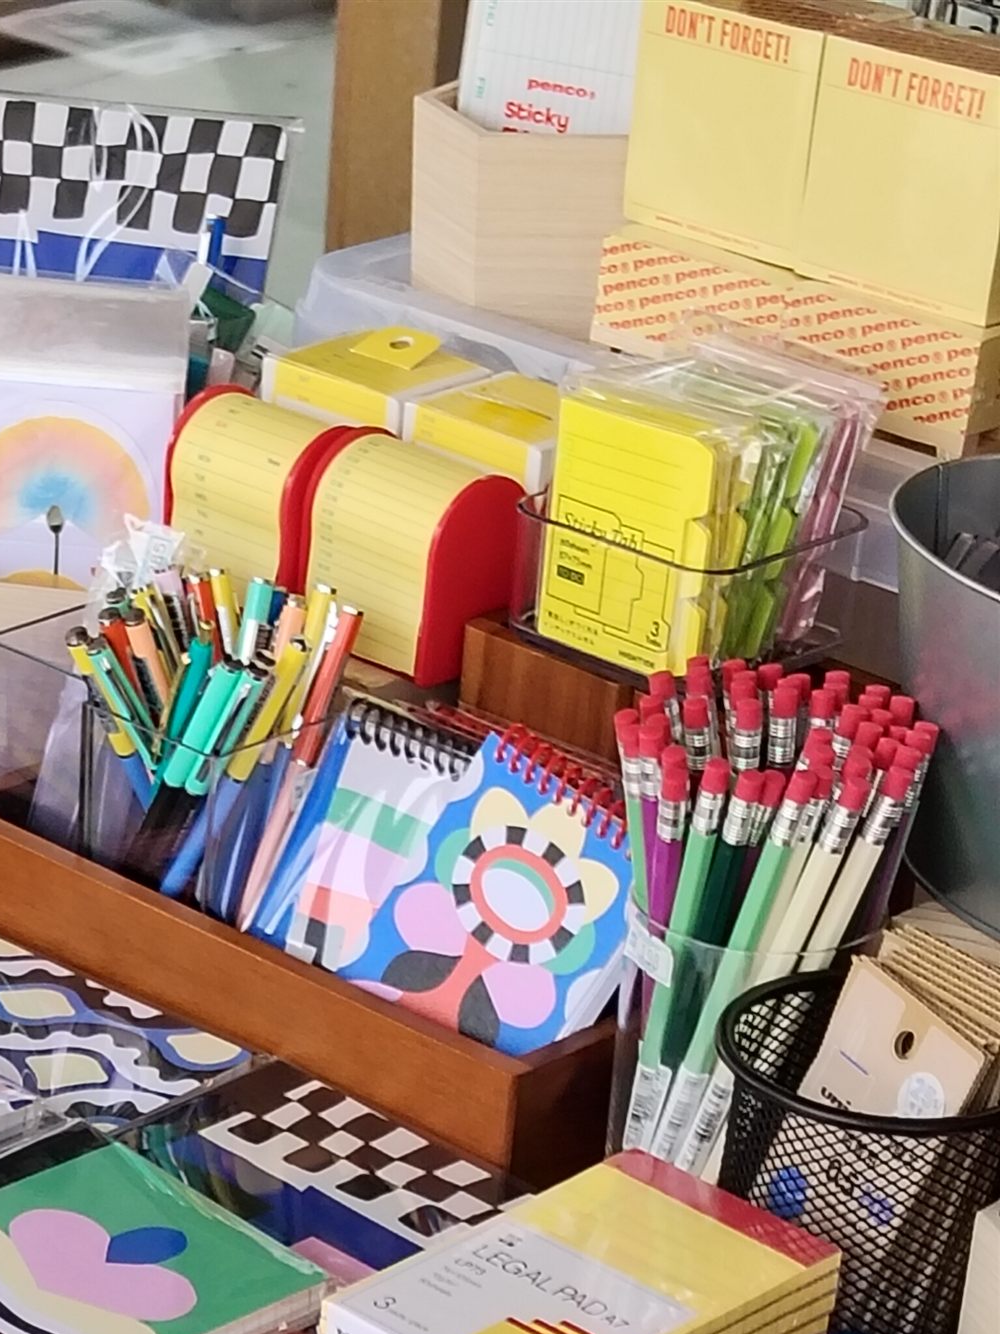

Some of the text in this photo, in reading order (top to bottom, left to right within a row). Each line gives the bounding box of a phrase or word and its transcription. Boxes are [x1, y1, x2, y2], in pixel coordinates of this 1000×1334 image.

[665, 5, 791, 63] DON'T FORGET!
[527, 78, 588, 98] penco
[847, 58, 986, 119] DON'T FORGET!
[504, 100, 570, 133] Sticky
[603, 274, 660, 296] penco
[639, 287, 697, 309] penco
[906, 366, 970, 389] penco
[472, 1244, 553, 1293] LEGAL
[552, 1286, 608, 1317] PAD
[604, 1314, 631, 1329] A7
